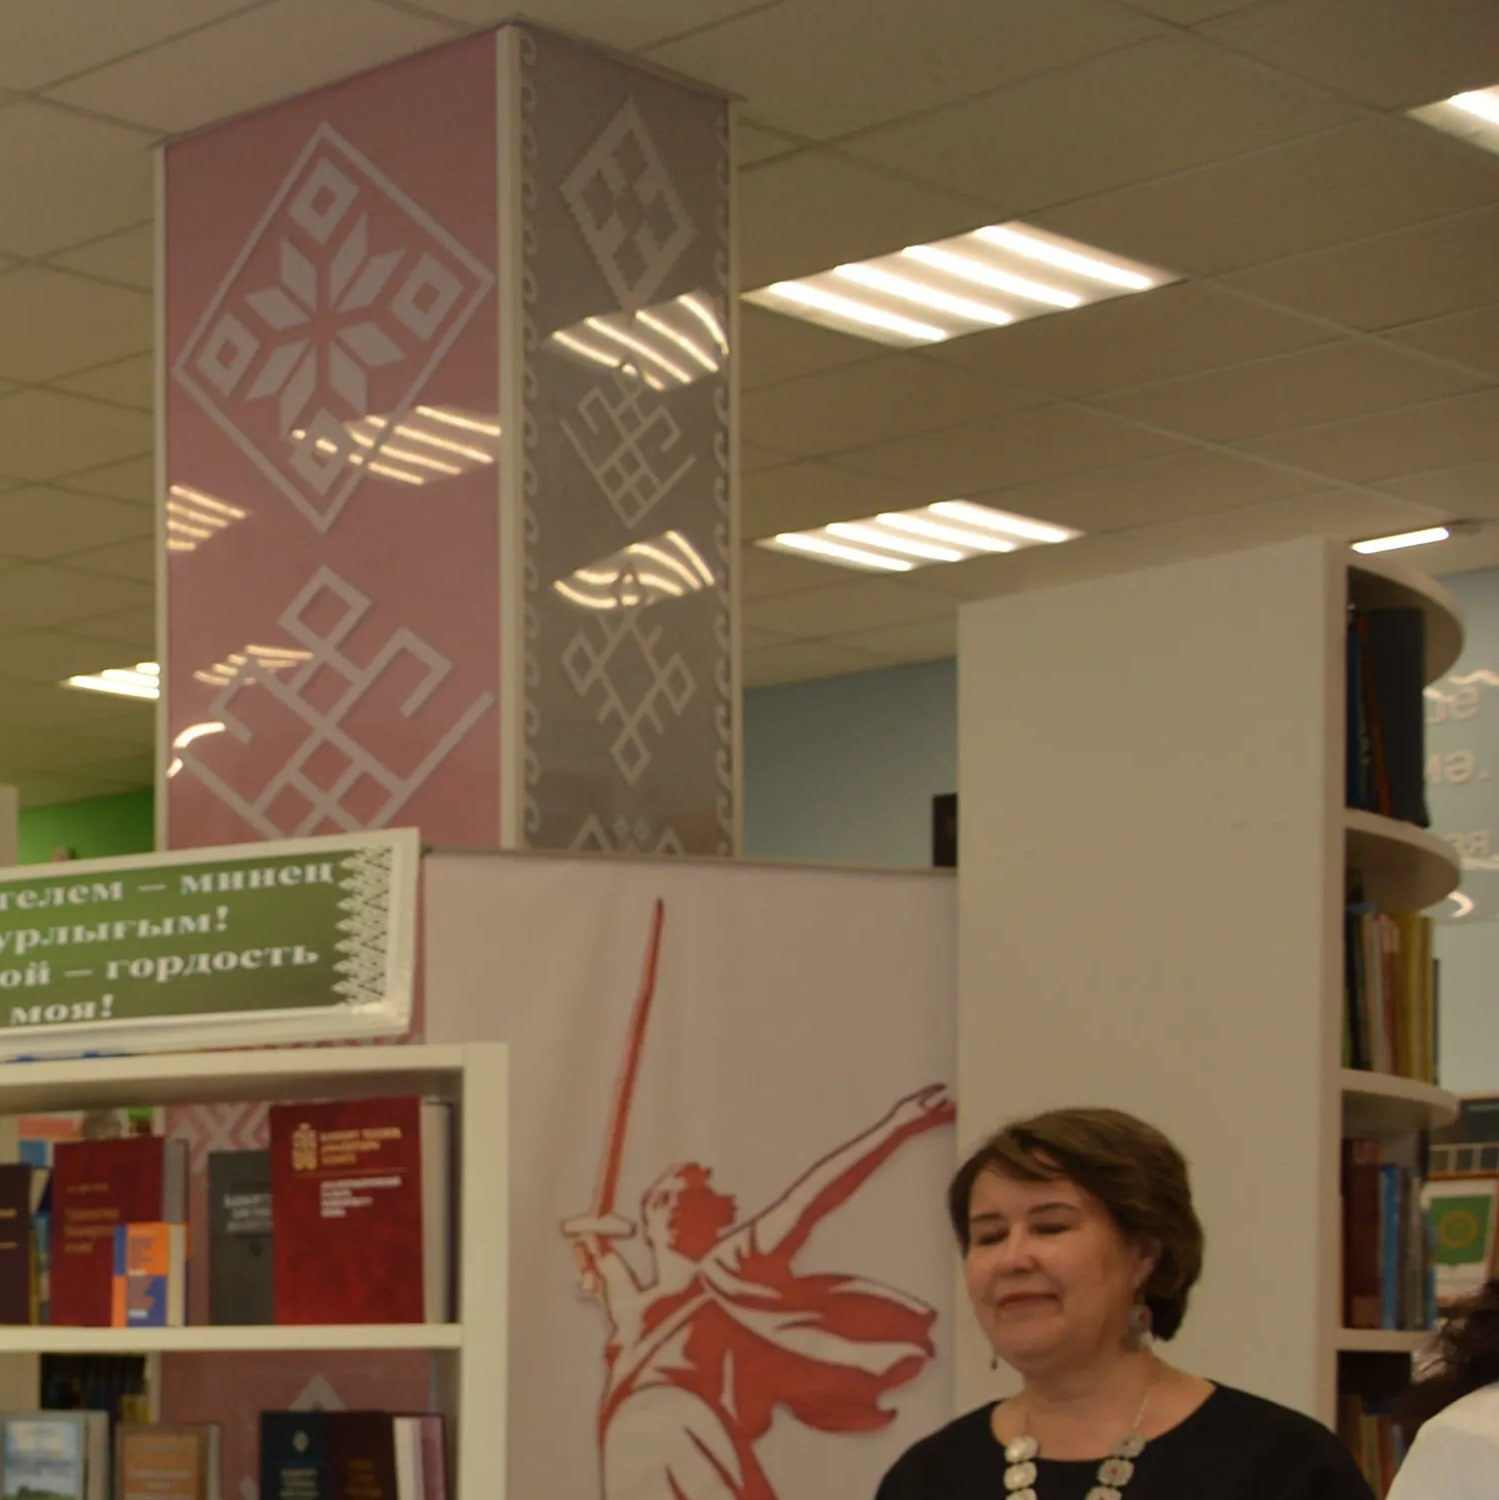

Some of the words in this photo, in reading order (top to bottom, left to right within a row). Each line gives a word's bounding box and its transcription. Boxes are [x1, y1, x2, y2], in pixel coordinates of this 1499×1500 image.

[180, 863, 334, 895] минең
[105, 944, 319, 983] гордость
[10, 993, 114, 1026] моя!
